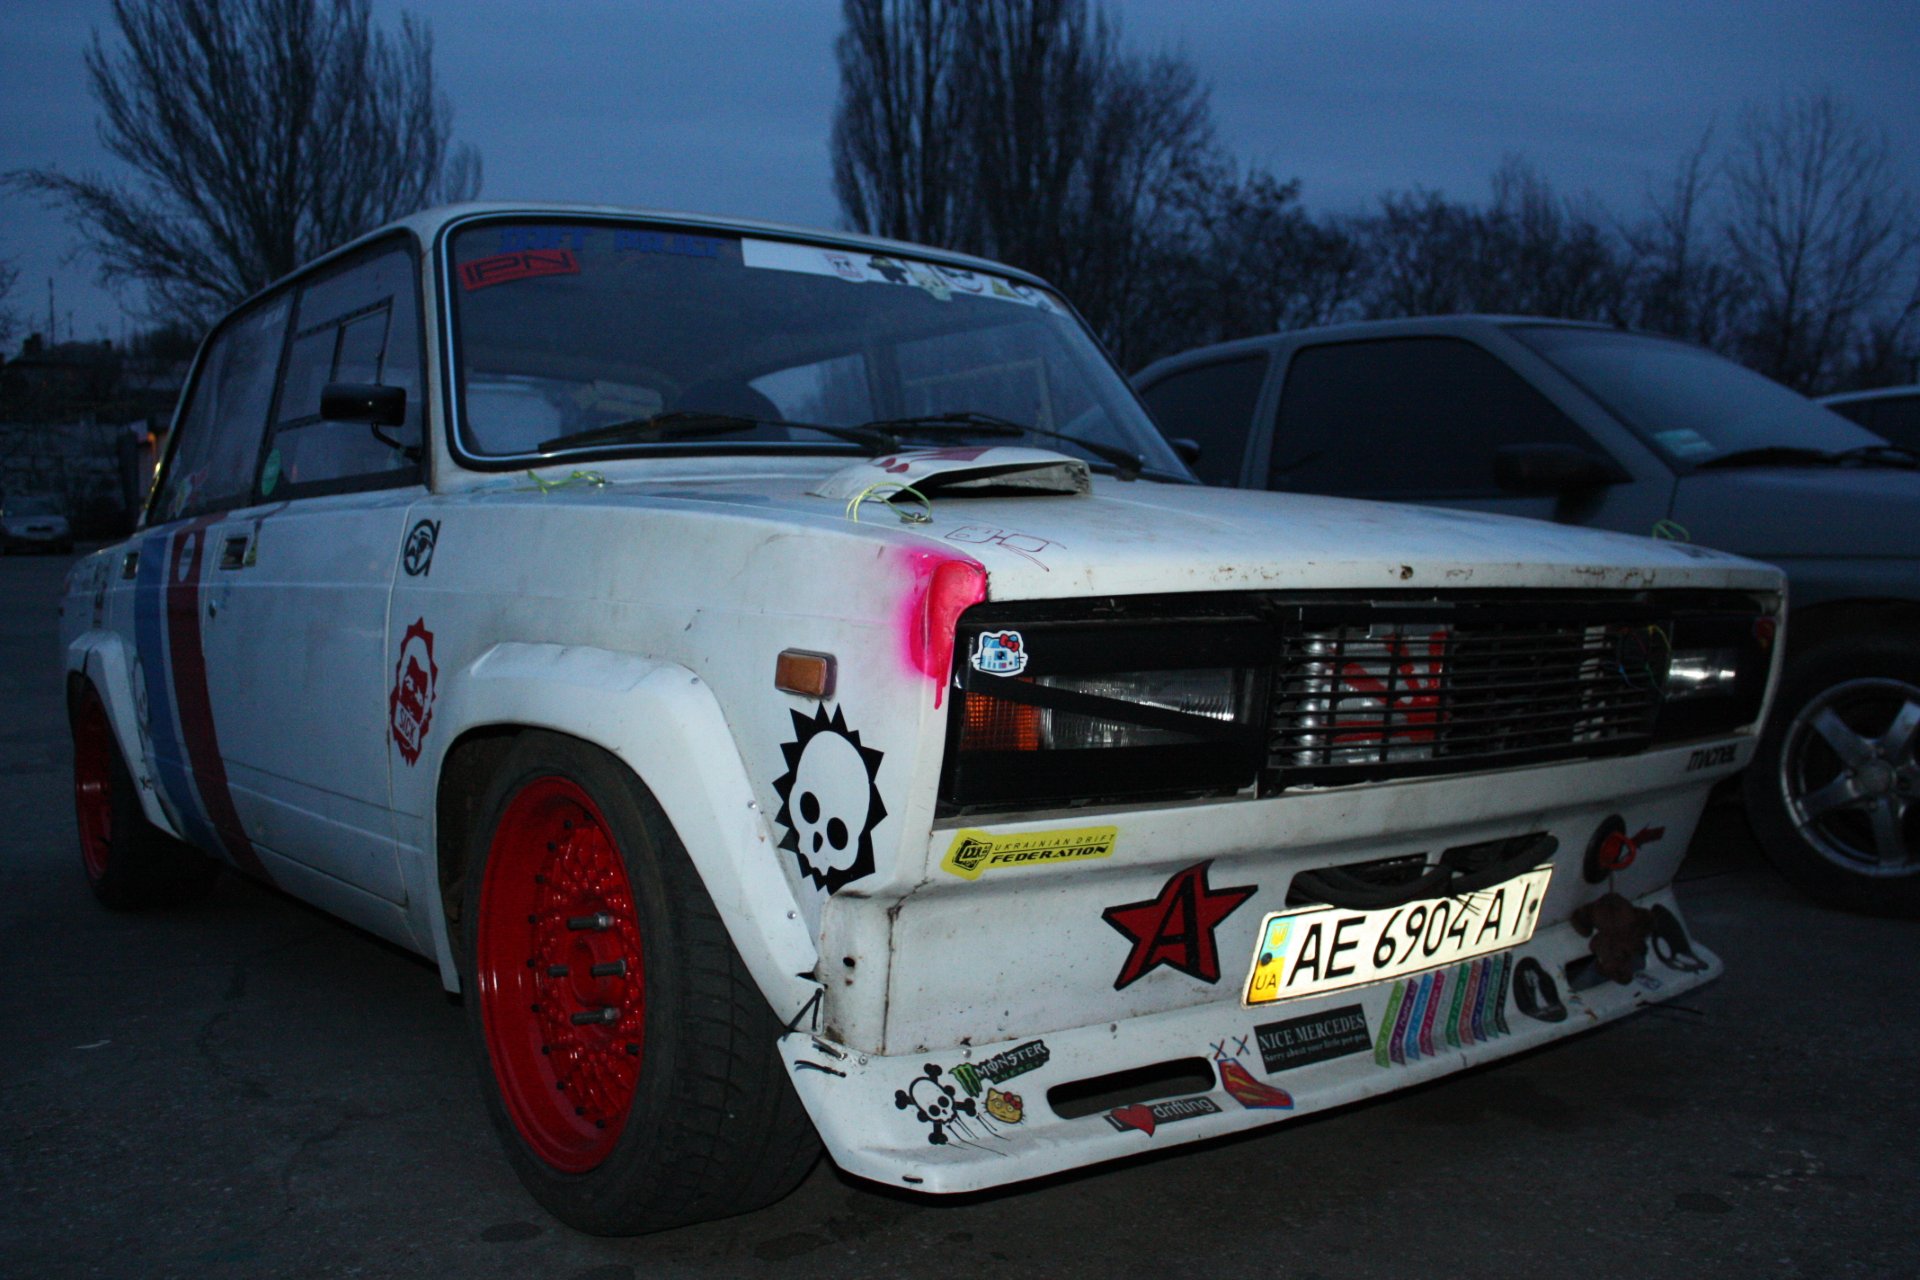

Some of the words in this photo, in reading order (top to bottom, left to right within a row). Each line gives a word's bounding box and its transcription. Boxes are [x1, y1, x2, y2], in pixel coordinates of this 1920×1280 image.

[400, 708, 416, 743] SICK
[990, 845, 1110, 864] FEDERATION
[995, 839, 1070, 851] UKRAINIAN
[1076, 834, 1115, 845] DRIFT
[1287, 916, 1366, 986] AE
[1372, 895, 1475, 970] 6904
[1255, 973, 1277, 990] UA
[1259, 1028, 1295, 1051] NICE
[1294, 1013, 1366, 1042] MERCEDES
[975, 1042, 1046, 1077] MONSTER
[1264, 1053, 1286, 1063] Sorry
[1287, 1046, 1307, 1057] about
[1109, 1116, 1123, 1128] I
[1154, 1099, 1215, 1118] drifting
